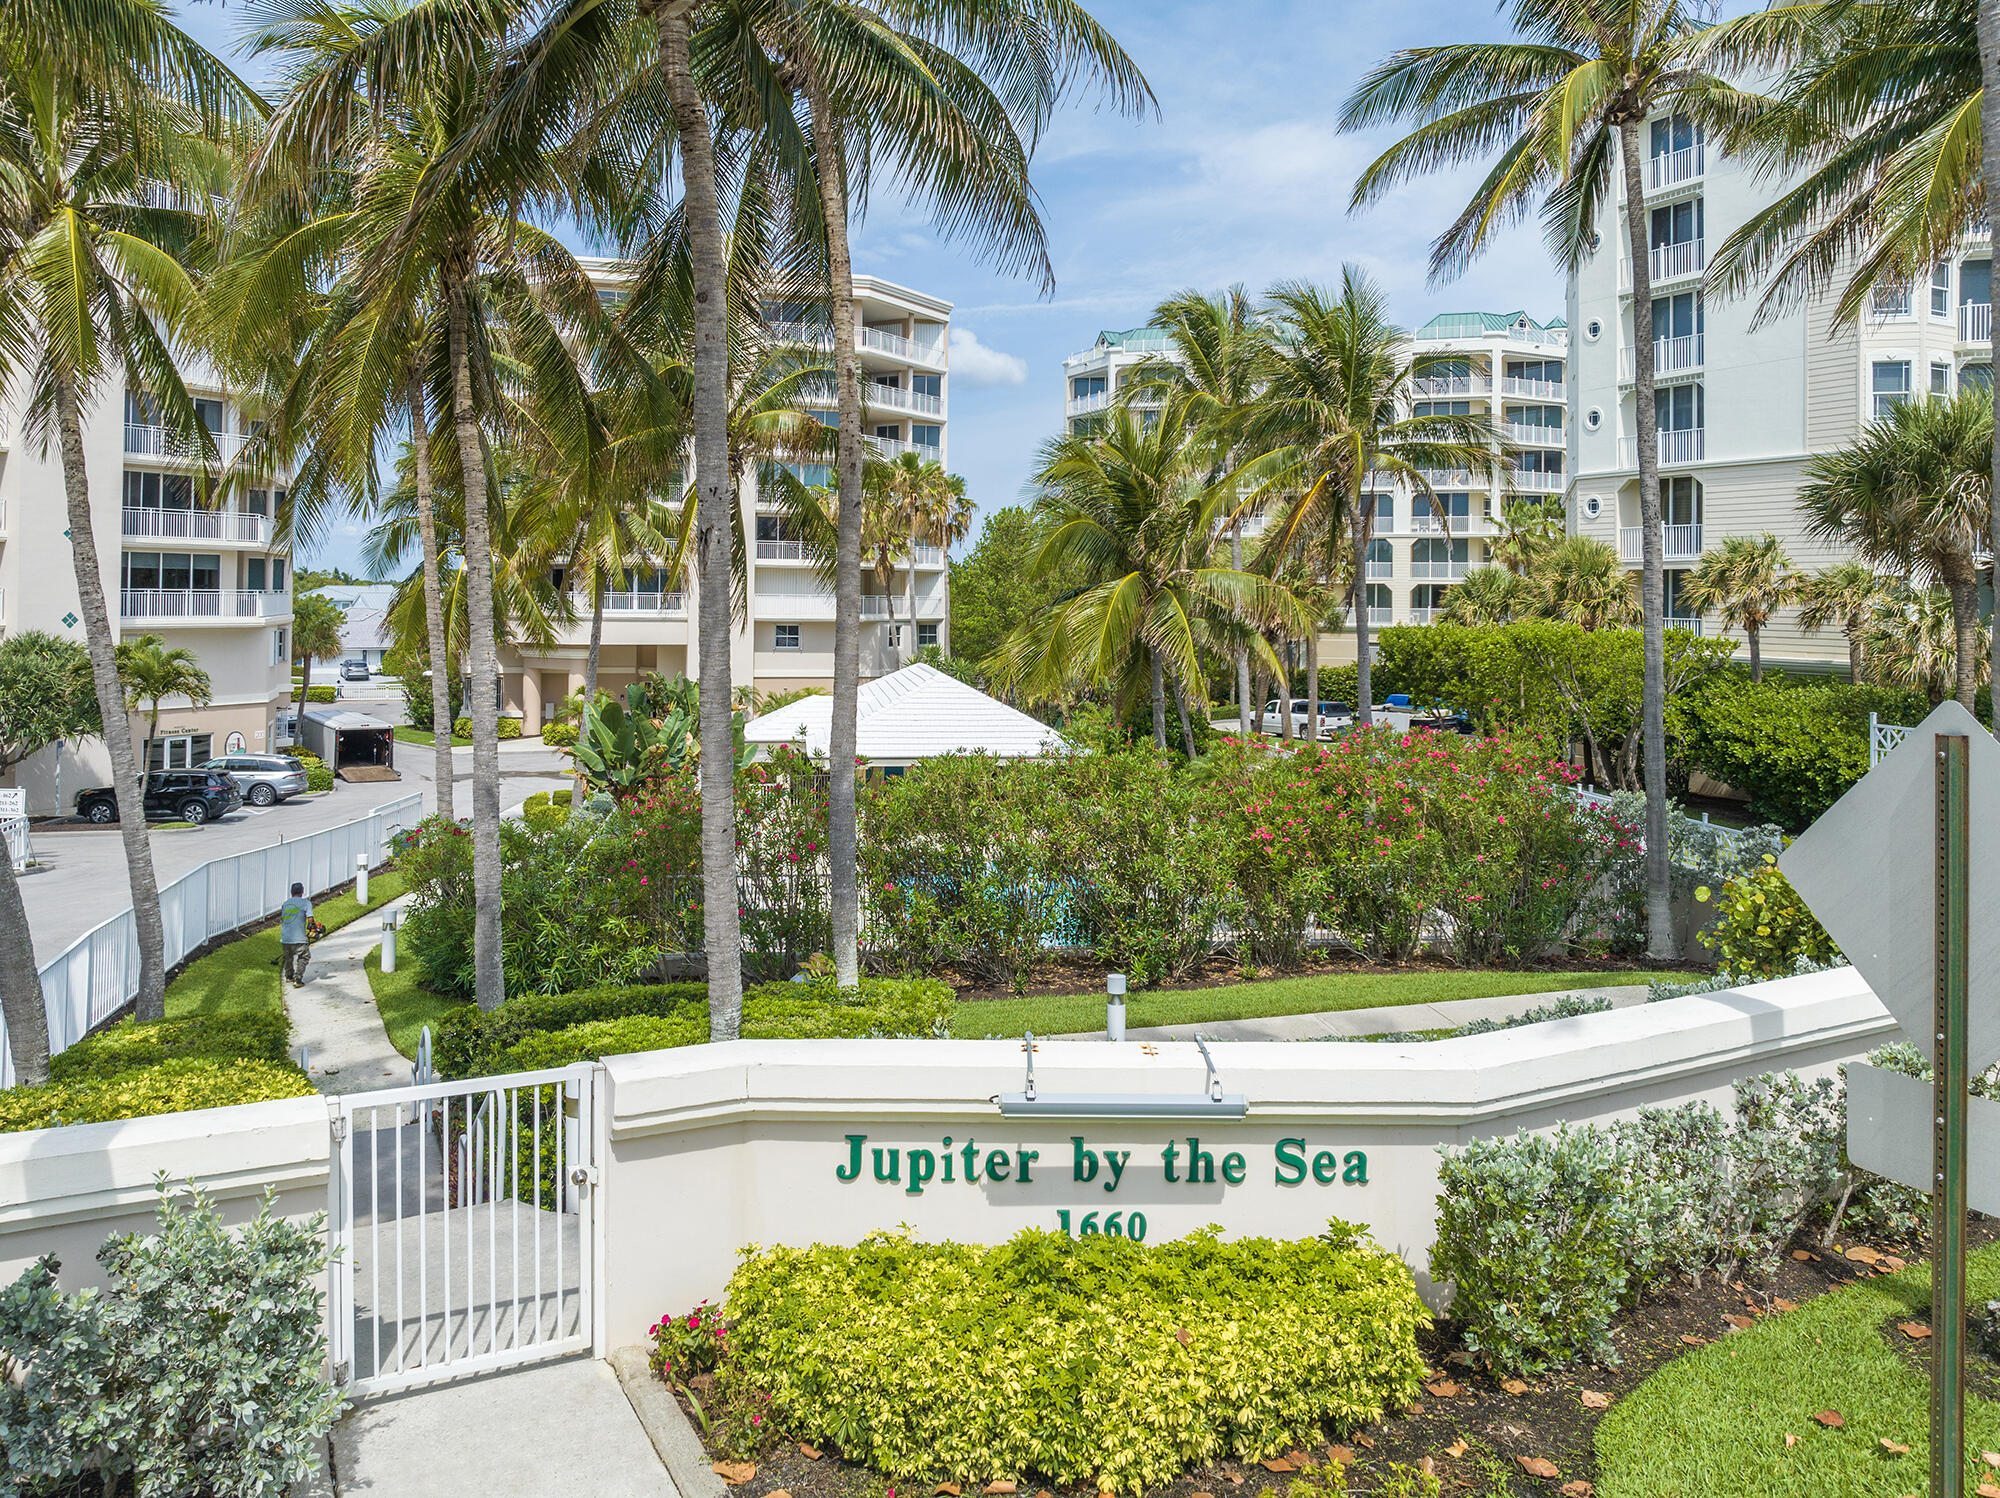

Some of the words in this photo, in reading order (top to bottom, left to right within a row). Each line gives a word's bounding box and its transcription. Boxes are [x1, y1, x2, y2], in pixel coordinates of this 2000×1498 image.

[836, 1134, 1039, 1192] Jupiter
[1071, 1136, 1131, 1192] by
[1161, 1137, 1247, 1184] the
[1274, 1138, 1370, 1185] Sea
[1056, 1209, 1148, 1242] 1660
